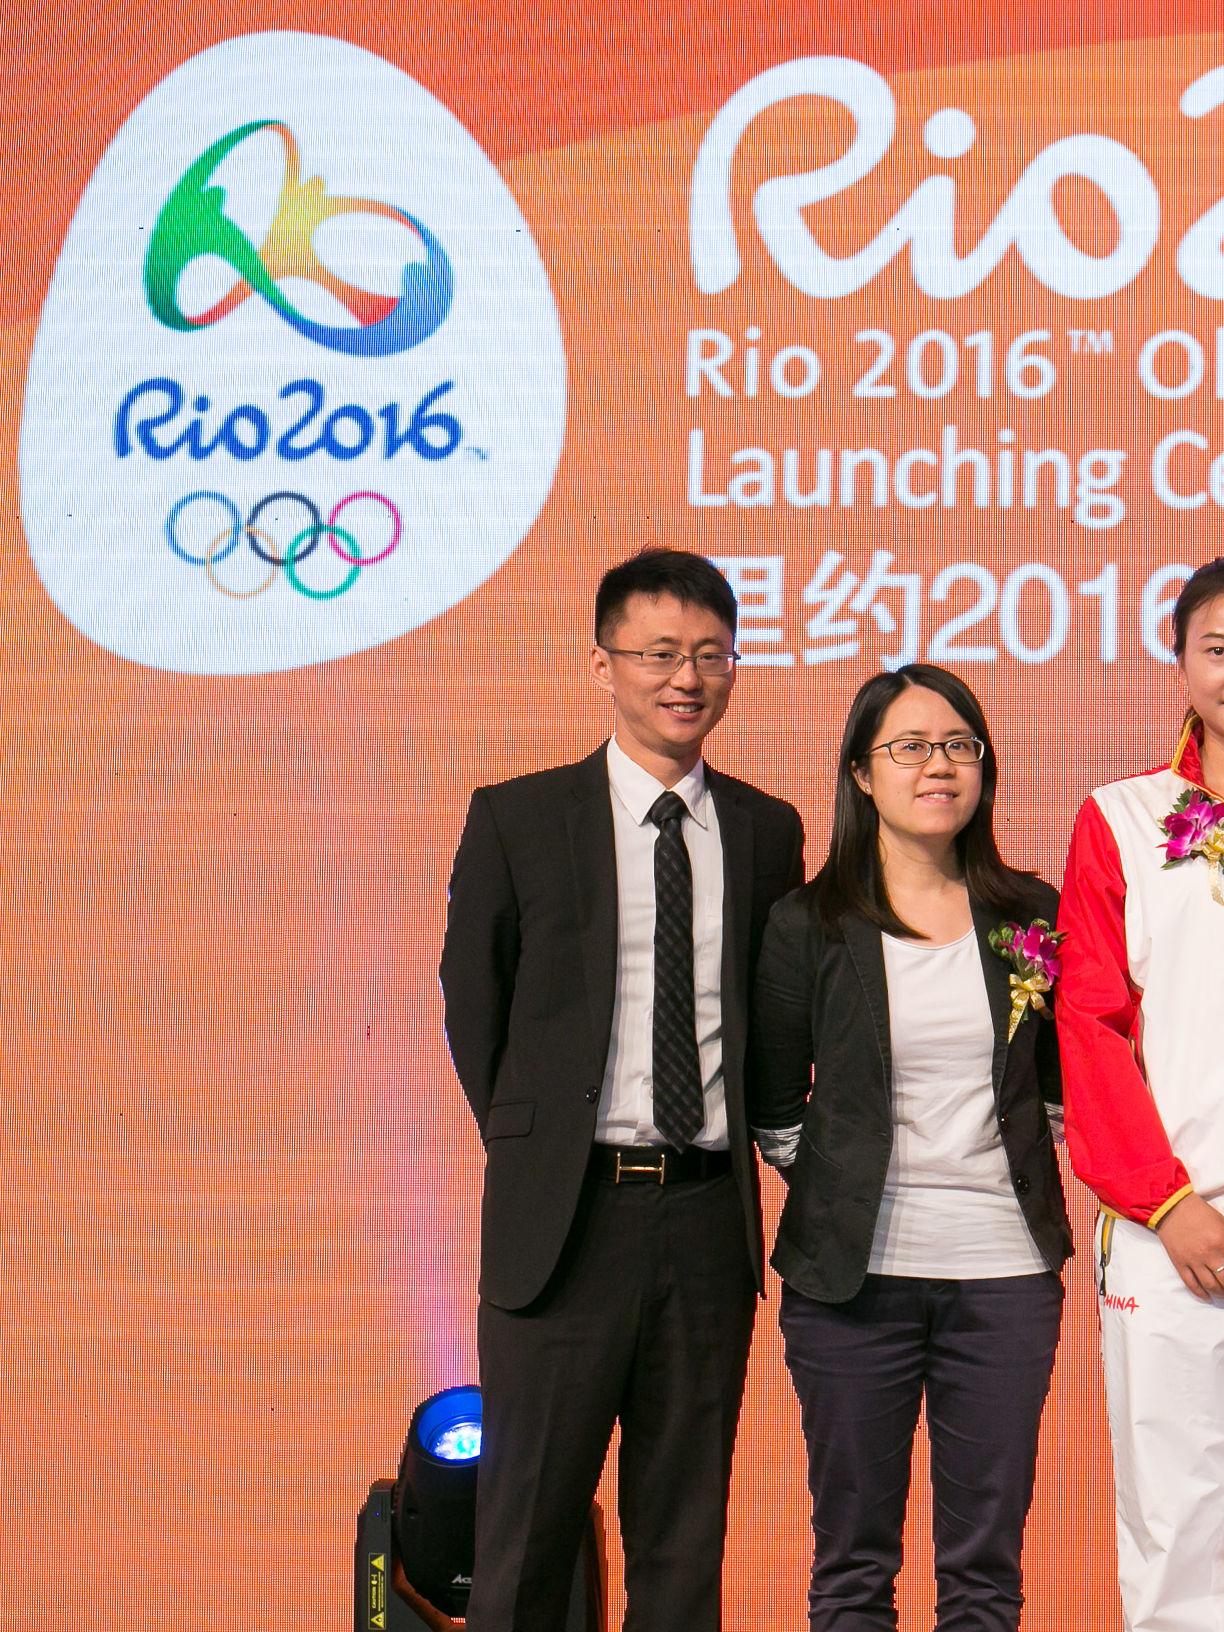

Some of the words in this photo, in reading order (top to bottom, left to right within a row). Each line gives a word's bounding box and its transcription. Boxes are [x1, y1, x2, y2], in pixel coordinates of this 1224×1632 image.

[686, 325, 822, 399] Rio
[687, 424, 1128, 531] Launching
[1104, 1294, 1139, 1314] HINA
